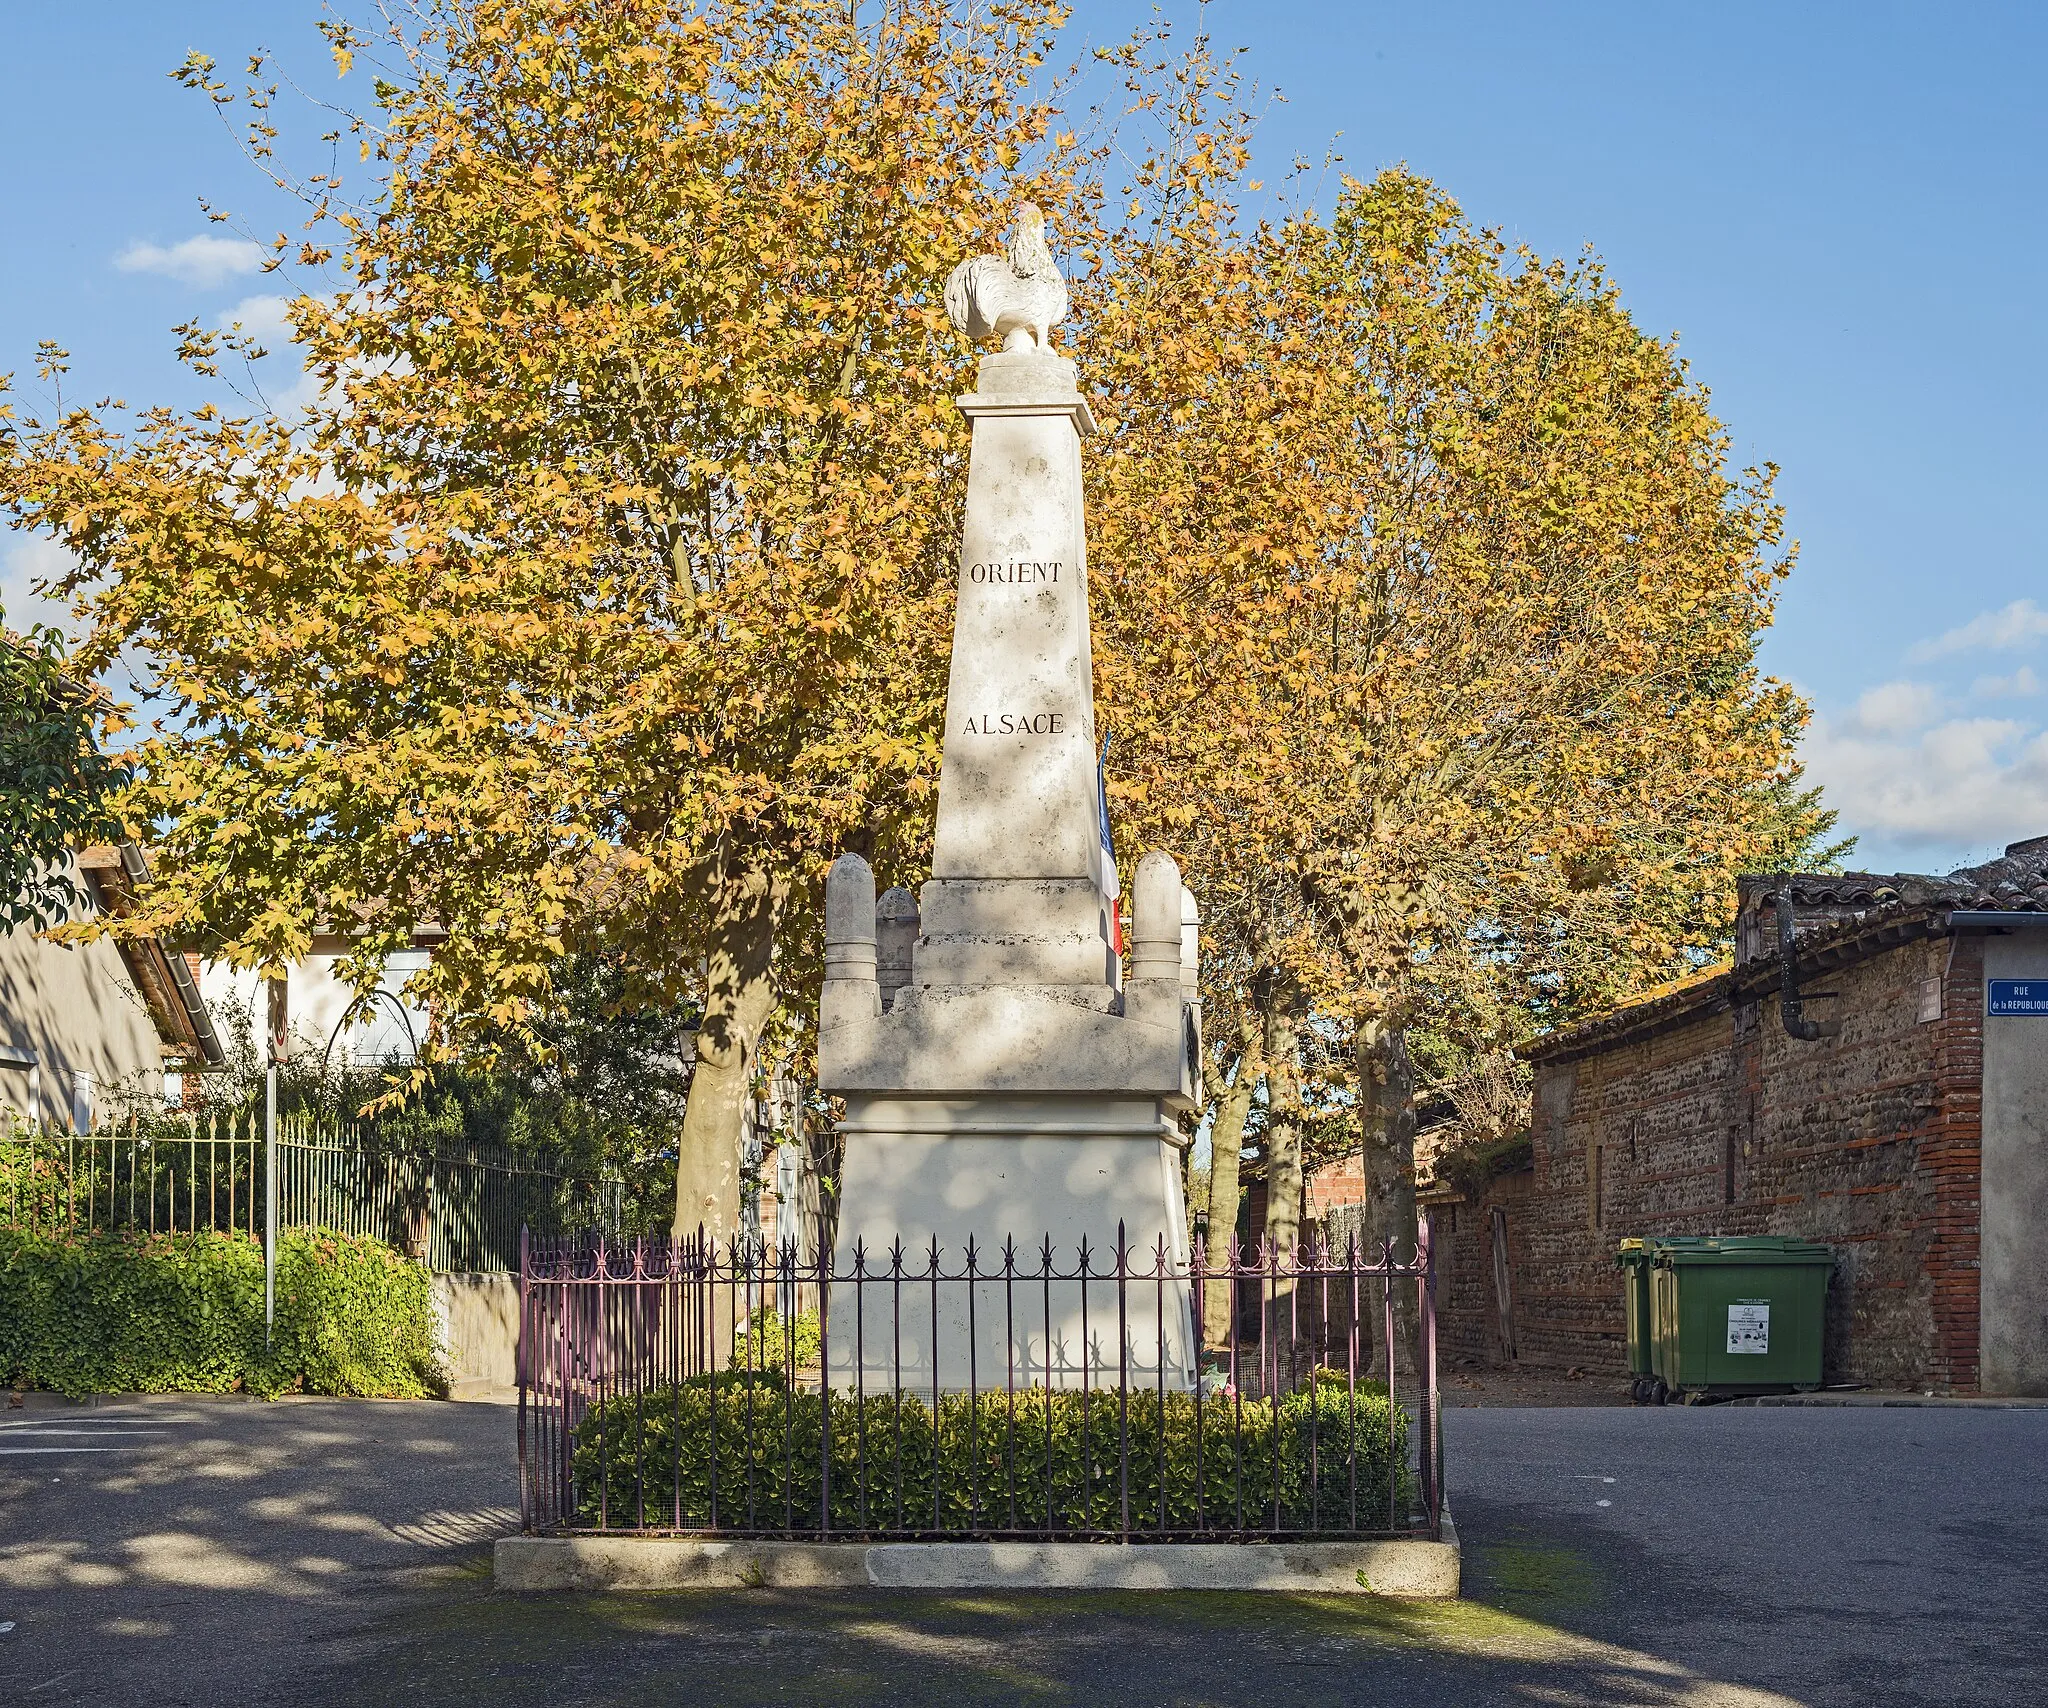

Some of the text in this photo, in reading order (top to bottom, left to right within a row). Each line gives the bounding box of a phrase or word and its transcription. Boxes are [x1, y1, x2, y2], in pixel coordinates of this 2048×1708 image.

[963, 714, 1064, 735] ALSACE
[2014, 986, 2029, 996] RUE
[1992, 1000, 2000, 1010] de
[2001, 1000, 2007, 1010] la
